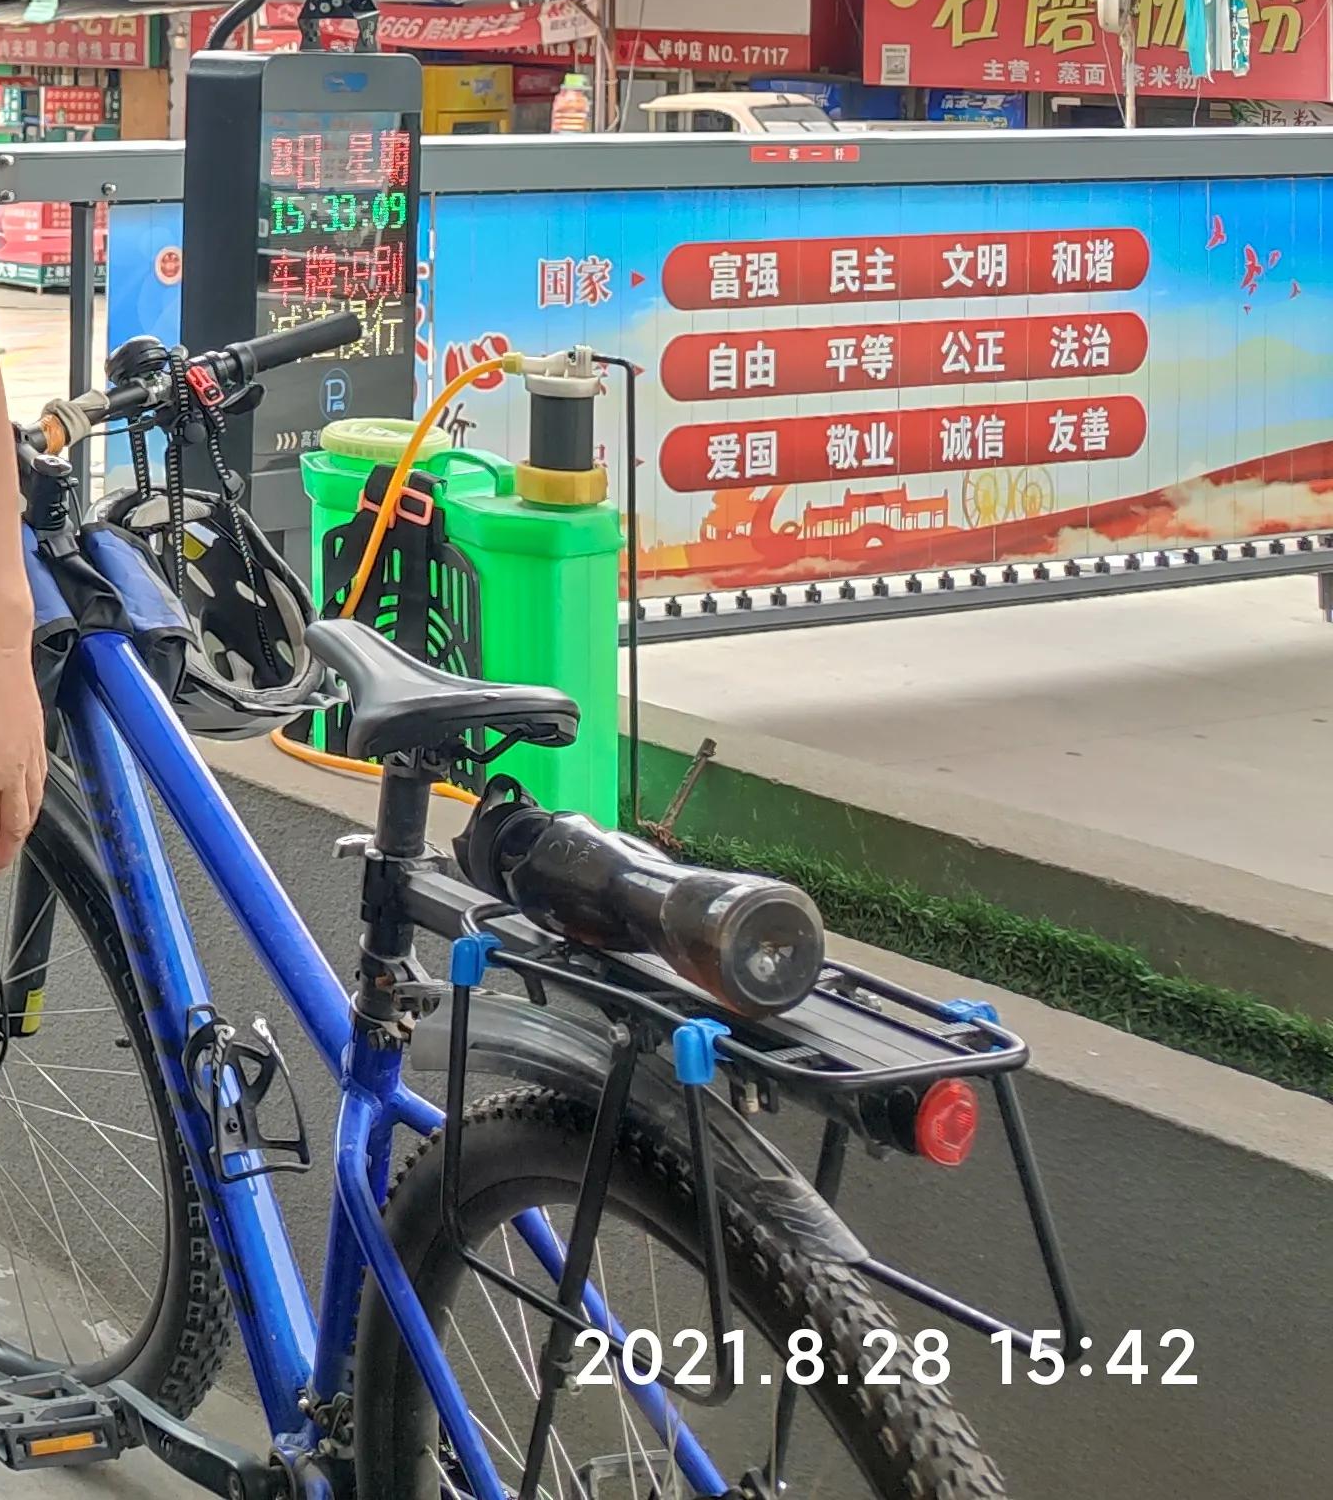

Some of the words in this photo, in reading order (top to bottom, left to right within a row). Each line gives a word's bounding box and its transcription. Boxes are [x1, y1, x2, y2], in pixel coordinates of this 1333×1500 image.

[766, 147, 844, 162] 一车一杆
[539, 255, 613, 308] 国家
[708, 249, 780, 300] 富强
[830, 246, 896, 294] 民主
[942, 243, 1008, 289] 文明
[1052, 239, 1114, 285] 和谐
[708, 343, 776, 390] 自由
[825, 335, 893, 383] 平等
[941, 329, 1006, 376] 公正
[1050, 322, 1112, 369] 法治
[708, 432, 779, 482] 爱国
[825, 424, 894, 472] 敬业
[941, 415, 1006, 462] 诚信
[1048, 407, 1111, 454] 友善
